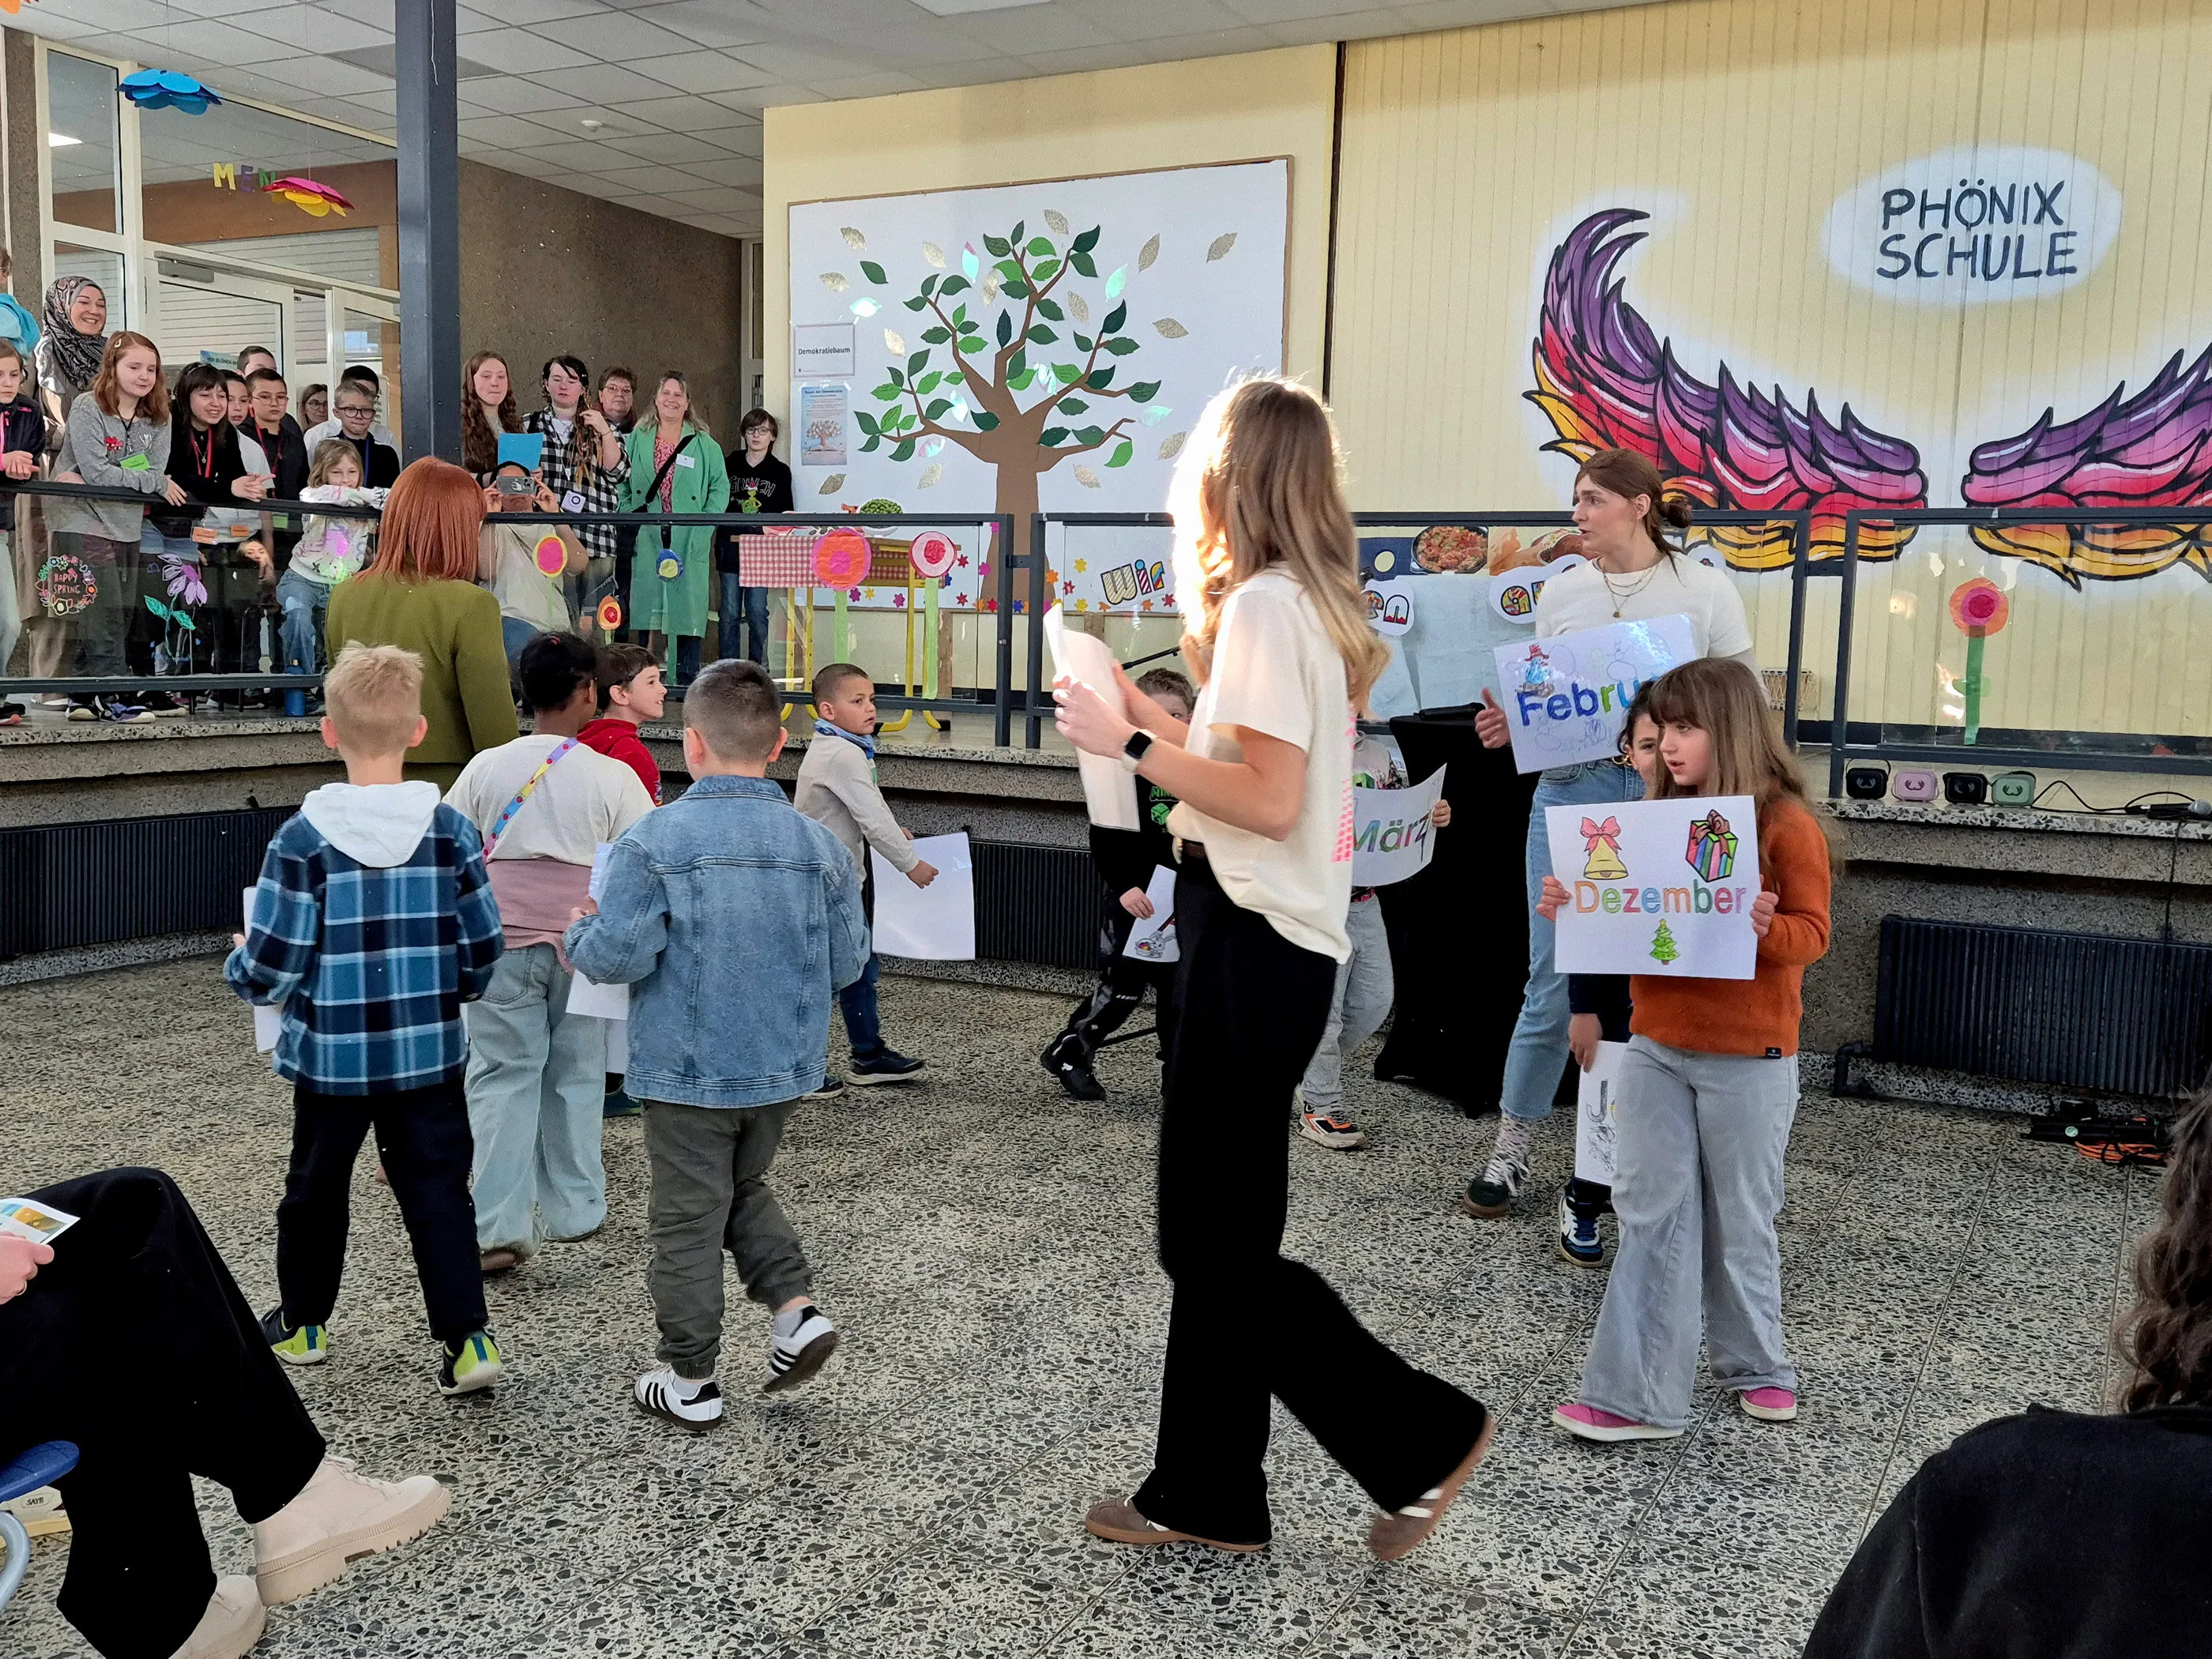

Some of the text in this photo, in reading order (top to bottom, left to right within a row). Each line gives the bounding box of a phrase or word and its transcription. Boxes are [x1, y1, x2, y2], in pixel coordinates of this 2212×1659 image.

[213, 163, 277, 193] MEN
[1882, 179, 2064, 231] PHÖNIX
[1876, 231, 2077, 281] SCHULE
[798, 347, 851, 356] Demokratiebaum
[54, 585, 80, 594] SPRING
[55, 573, 77, 583] HAPPY
[1516, 679, 1643, 727] Febru
[1352, 810, 1431, 855] März
[1574, 878, 1747, 914] Dezember
